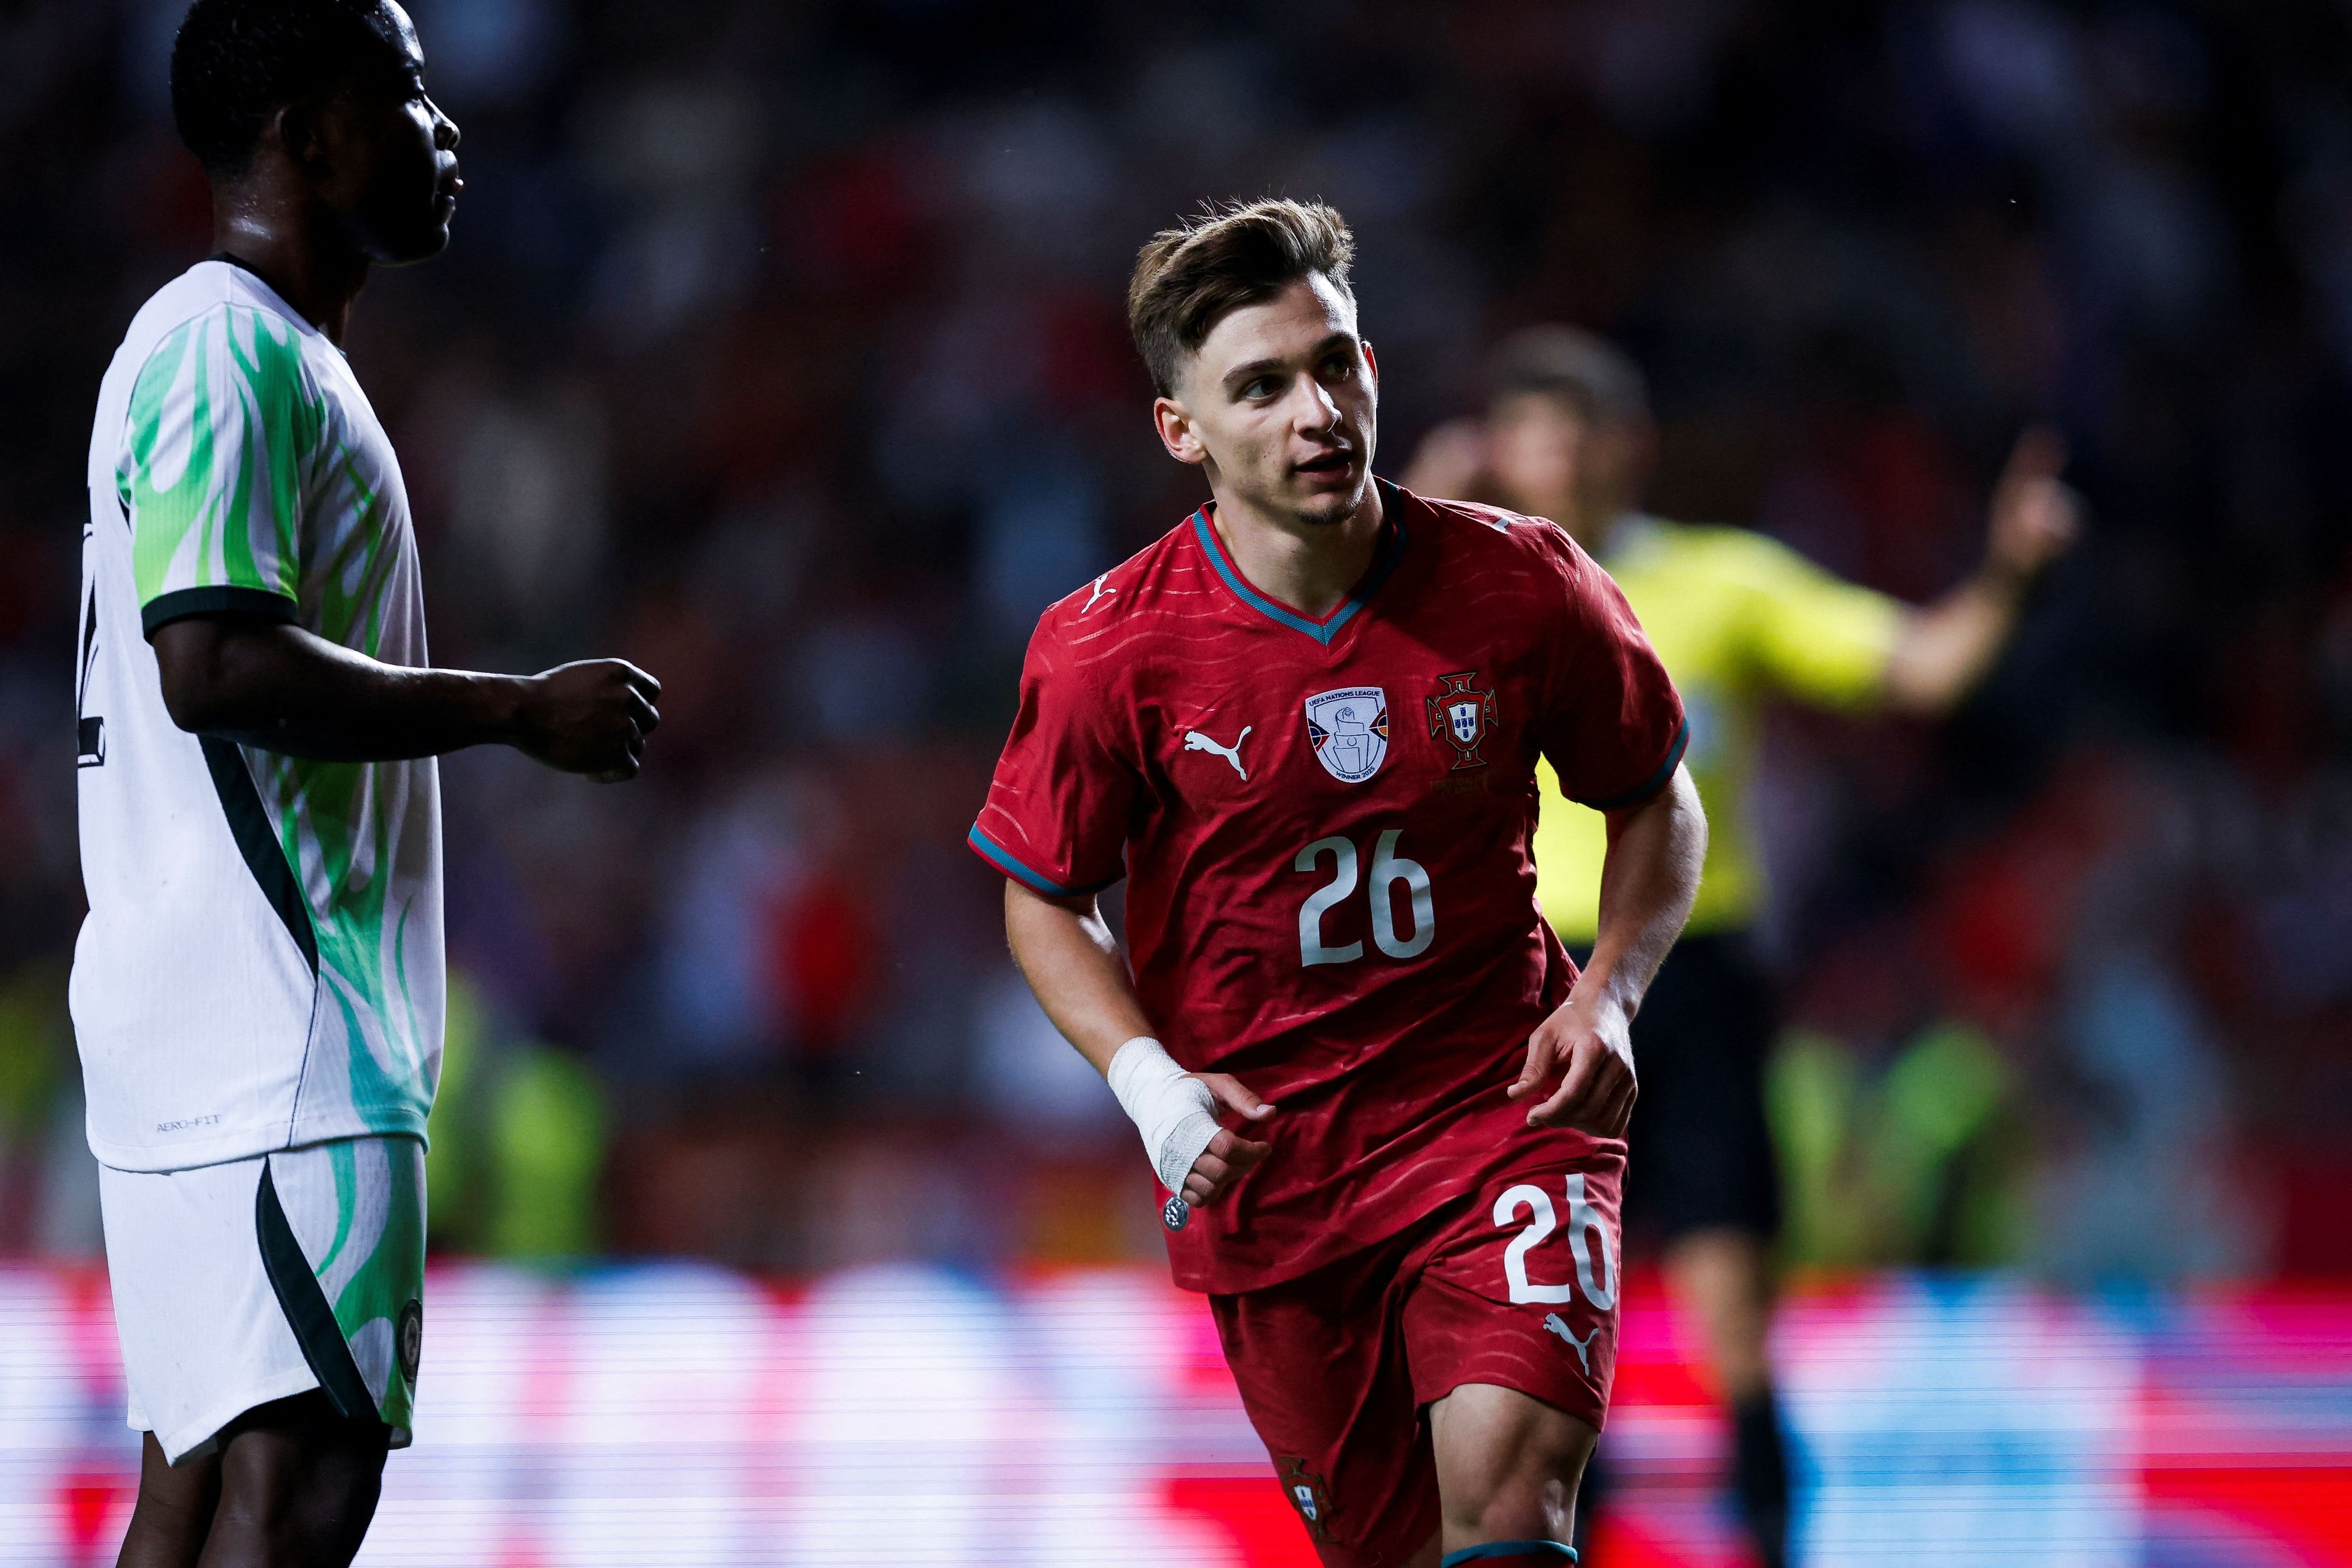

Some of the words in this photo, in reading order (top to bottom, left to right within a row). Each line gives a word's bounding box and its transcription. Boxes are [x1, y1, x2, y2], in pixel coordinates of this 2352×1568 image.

[1309, 697, 1325, 706] UEFA
[1325, 691, 1354, 701] NATIONS
[1336, 771, 1362, 780] WINNER
[1361, 765, 1376, 778] 2025
[1295, 829, 1435, 967] 26
[157, 1114, 221, 1133] AERO-FIT
[1492, 1172, 1615, 1311] 26
